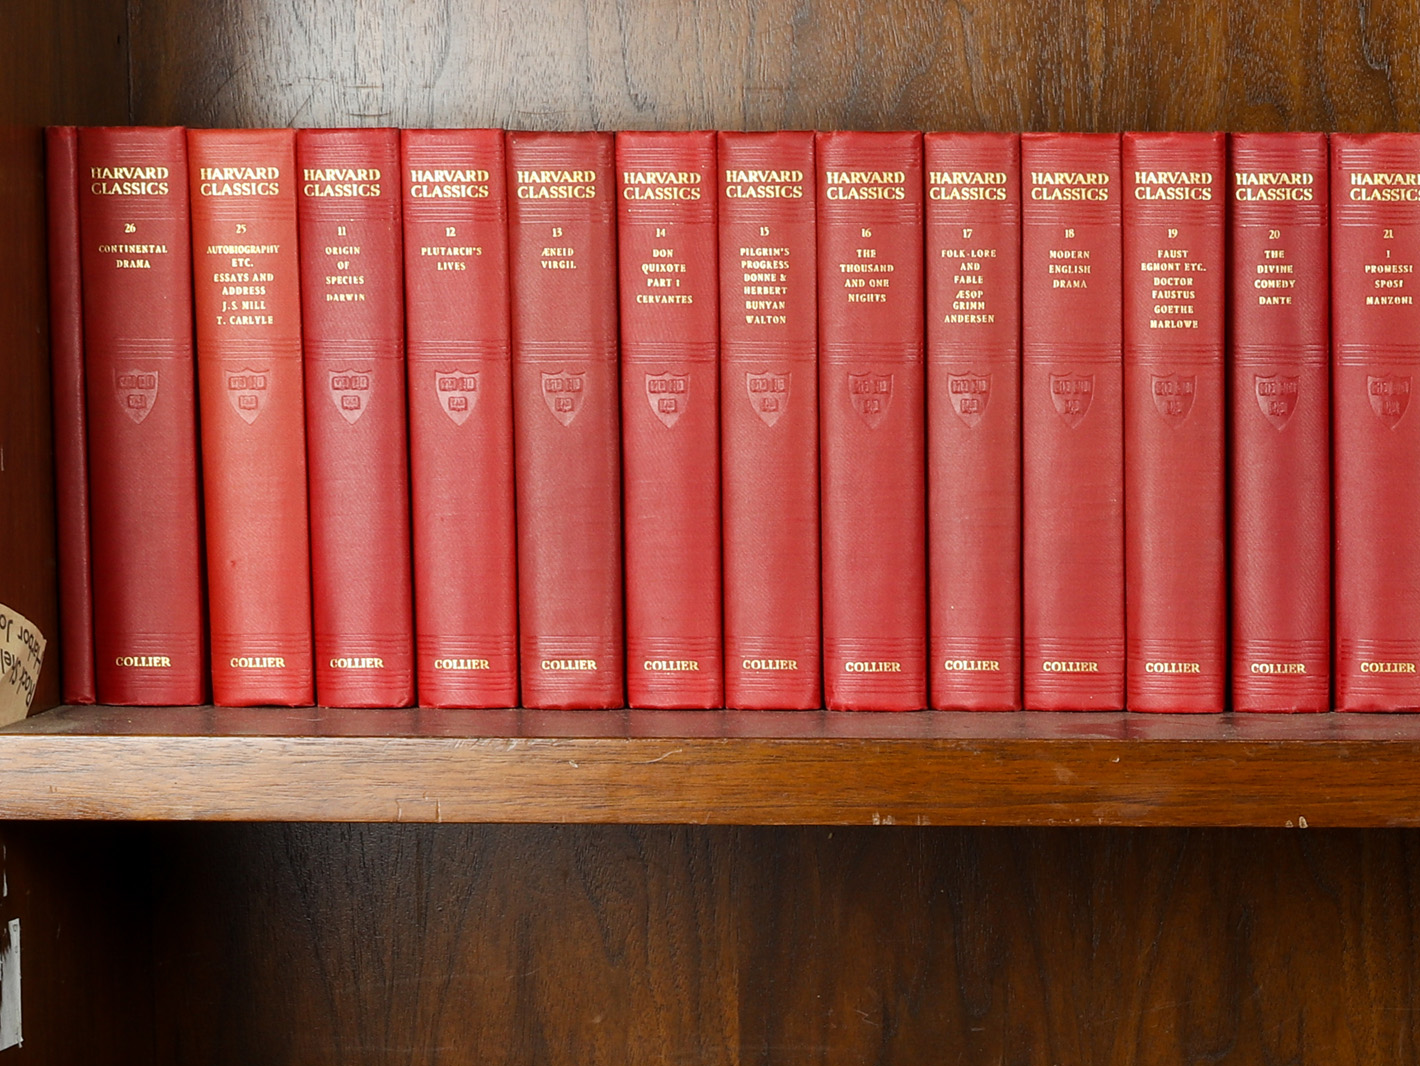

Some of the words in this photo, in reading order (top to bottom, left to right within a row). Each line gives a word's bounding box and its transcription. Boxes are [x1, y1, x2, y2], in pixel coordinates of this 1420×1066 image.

[91, 167, 169, 179] HARVARD
[410, 170, 489, 182] HARVARD
[1031, 172, 1109, 185] HARVARD
[1235, 173, 1313, 185] HARVARD
[91, 182, 169, 195] CLASSICS
[411, 185, 489, 198] CLASSICS
[1031, 187, 1108, 201] CLASSICS
[1236, 188, 1313, 201] CLASSICS
[124, 223, 136, 233] 26
[446, 227, 456, 237] 12
[1065, 229, 1075, 238] 18
[1269, 230, 1280, 239] 20
[99, 245, 168, 253] CONTINENTAL
[421, 247, 482, 256] PLUTARCH'S
[1264, 250, 1284, 258] THE
[1050, 250, 1090, 259] MODERN
[116, 259, 151, 268] DRAMA
[438, 262, 466, 270] LIVES
[1049, 265, 1090, 274] ENGLISH
[1257, 265, 1293, 274] DIVINE
[1053, 280, 1087, 288] DRAMA
[1254, 279, 1295, 289] COMEDY
[1259, 296, 1291, 304] DANTE
[116, 656, 171, 667] COLLIER
[434, 659, 489, 669] COLLIER
[1043, 660, 1098, 672] COLLIER
[1251, 663, 1306, 674] COLLIER
